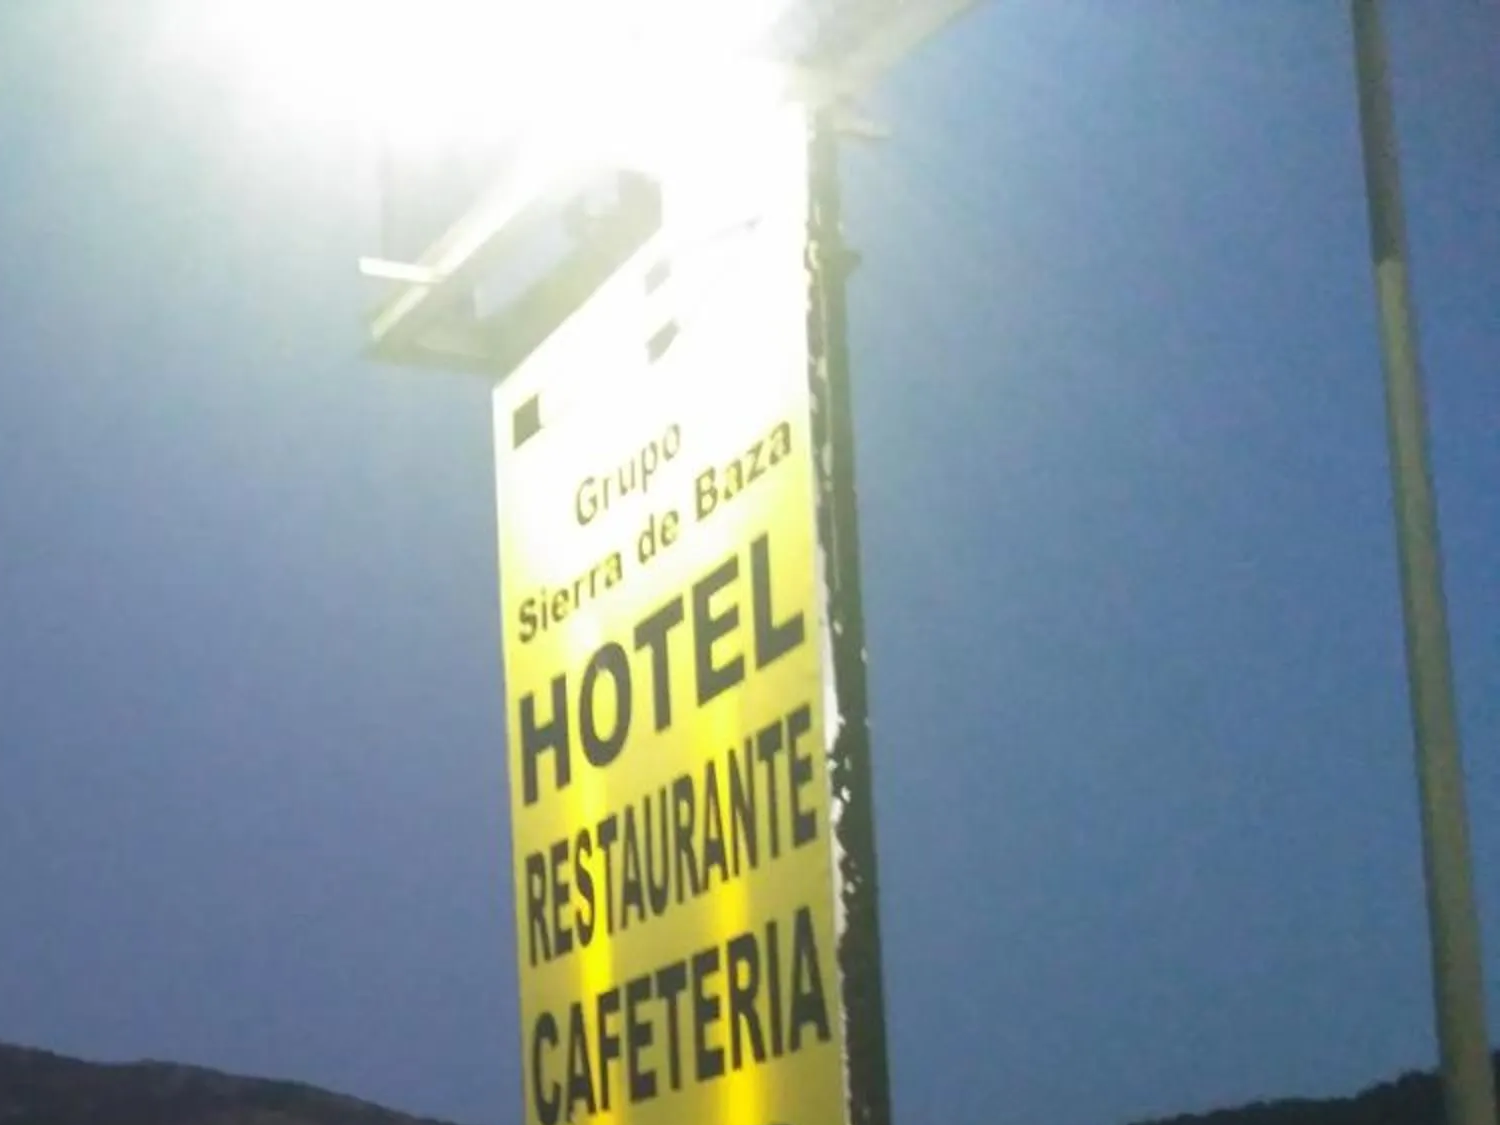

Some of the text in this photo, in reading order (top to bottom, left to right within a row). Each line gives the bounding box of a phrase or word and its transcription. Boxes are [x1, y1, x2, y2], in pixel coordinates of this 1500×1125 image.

[518, 420, 793, 644] Sierra de Baza
[574, 423, 682, 527] Grupo
[518, 532, 806, 807] HOTEL
[524, 702, 819, 968] RESTAURANTE
